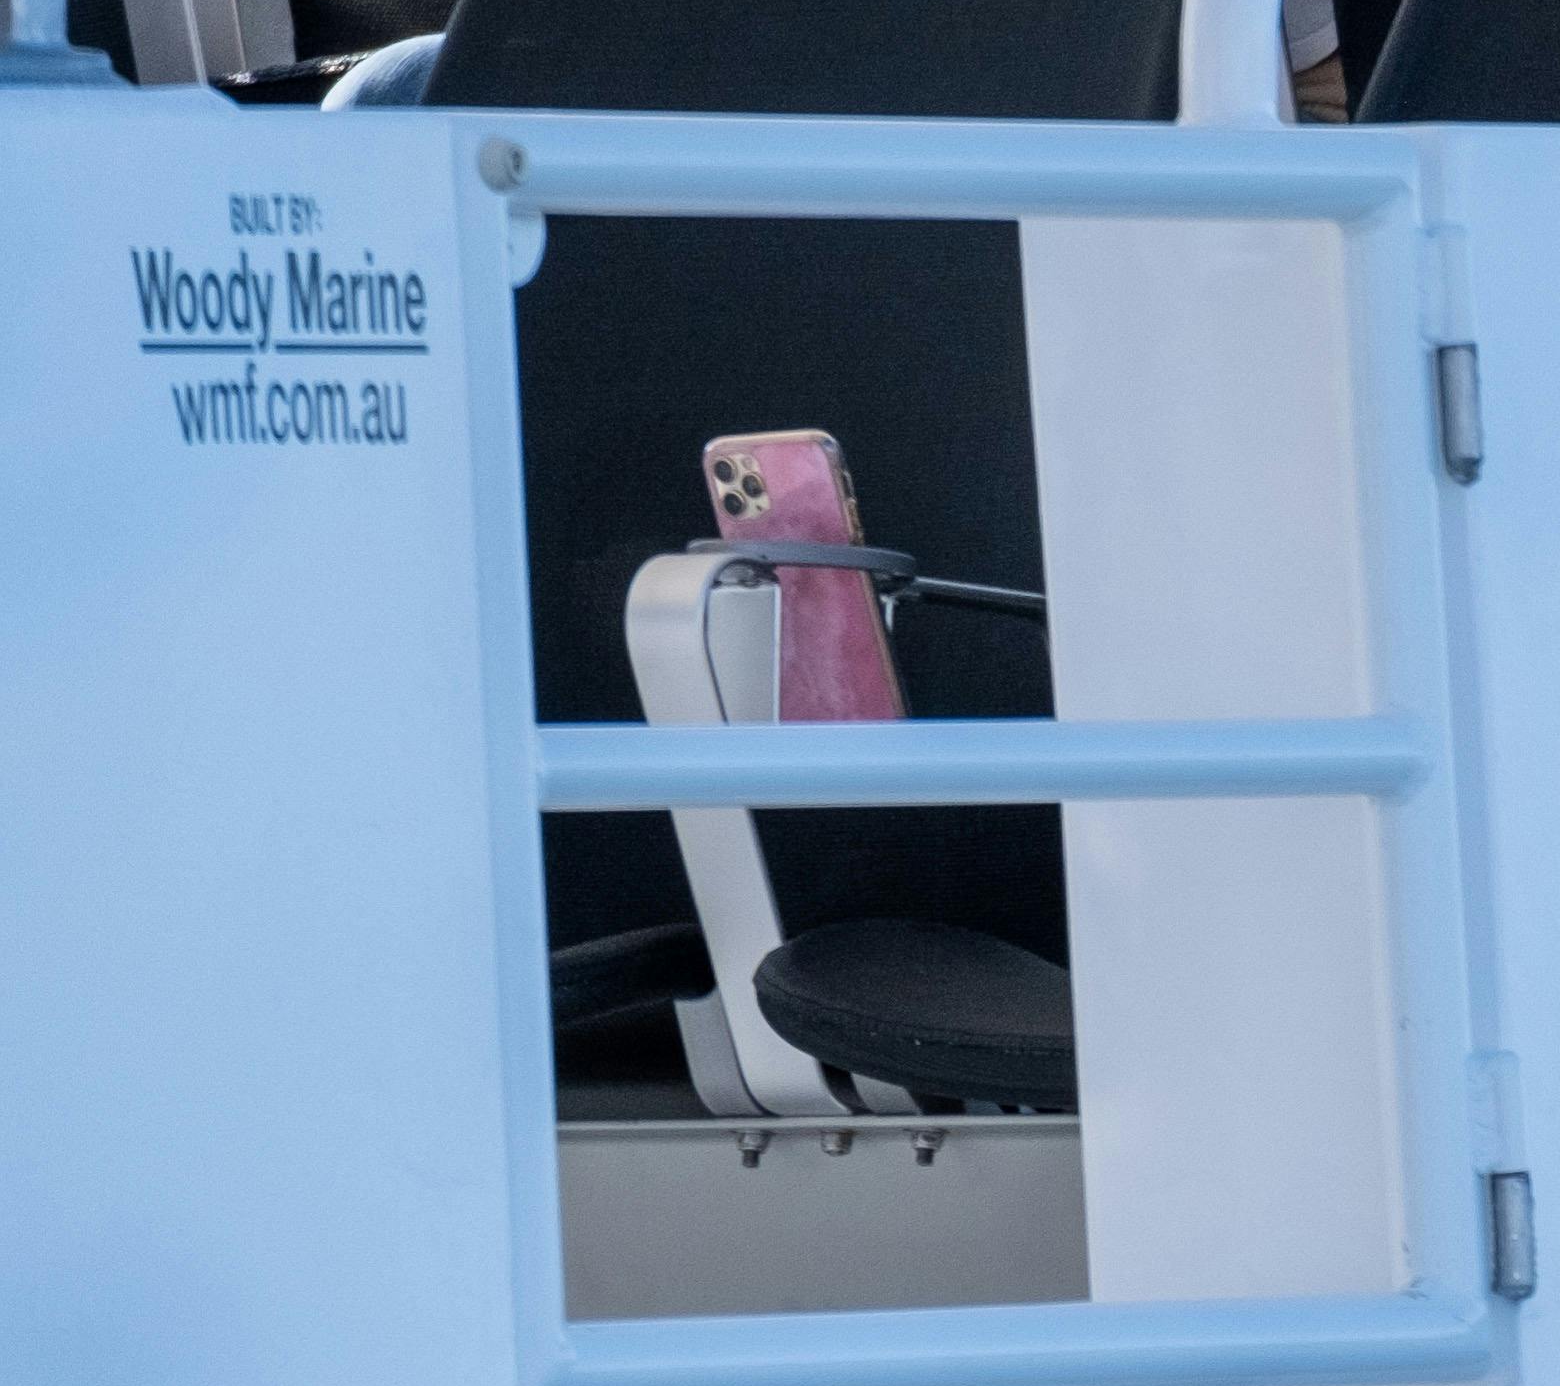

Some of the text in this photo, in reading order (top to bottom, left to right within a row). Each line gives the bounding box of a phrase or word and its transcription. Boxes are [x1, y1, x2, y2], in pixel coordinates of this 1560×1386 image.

[228, 192, 284, 235] BUILT
[130, 247, 428, 352] Woody Marine
[170, 359, 408, 446] wmf.com.au
